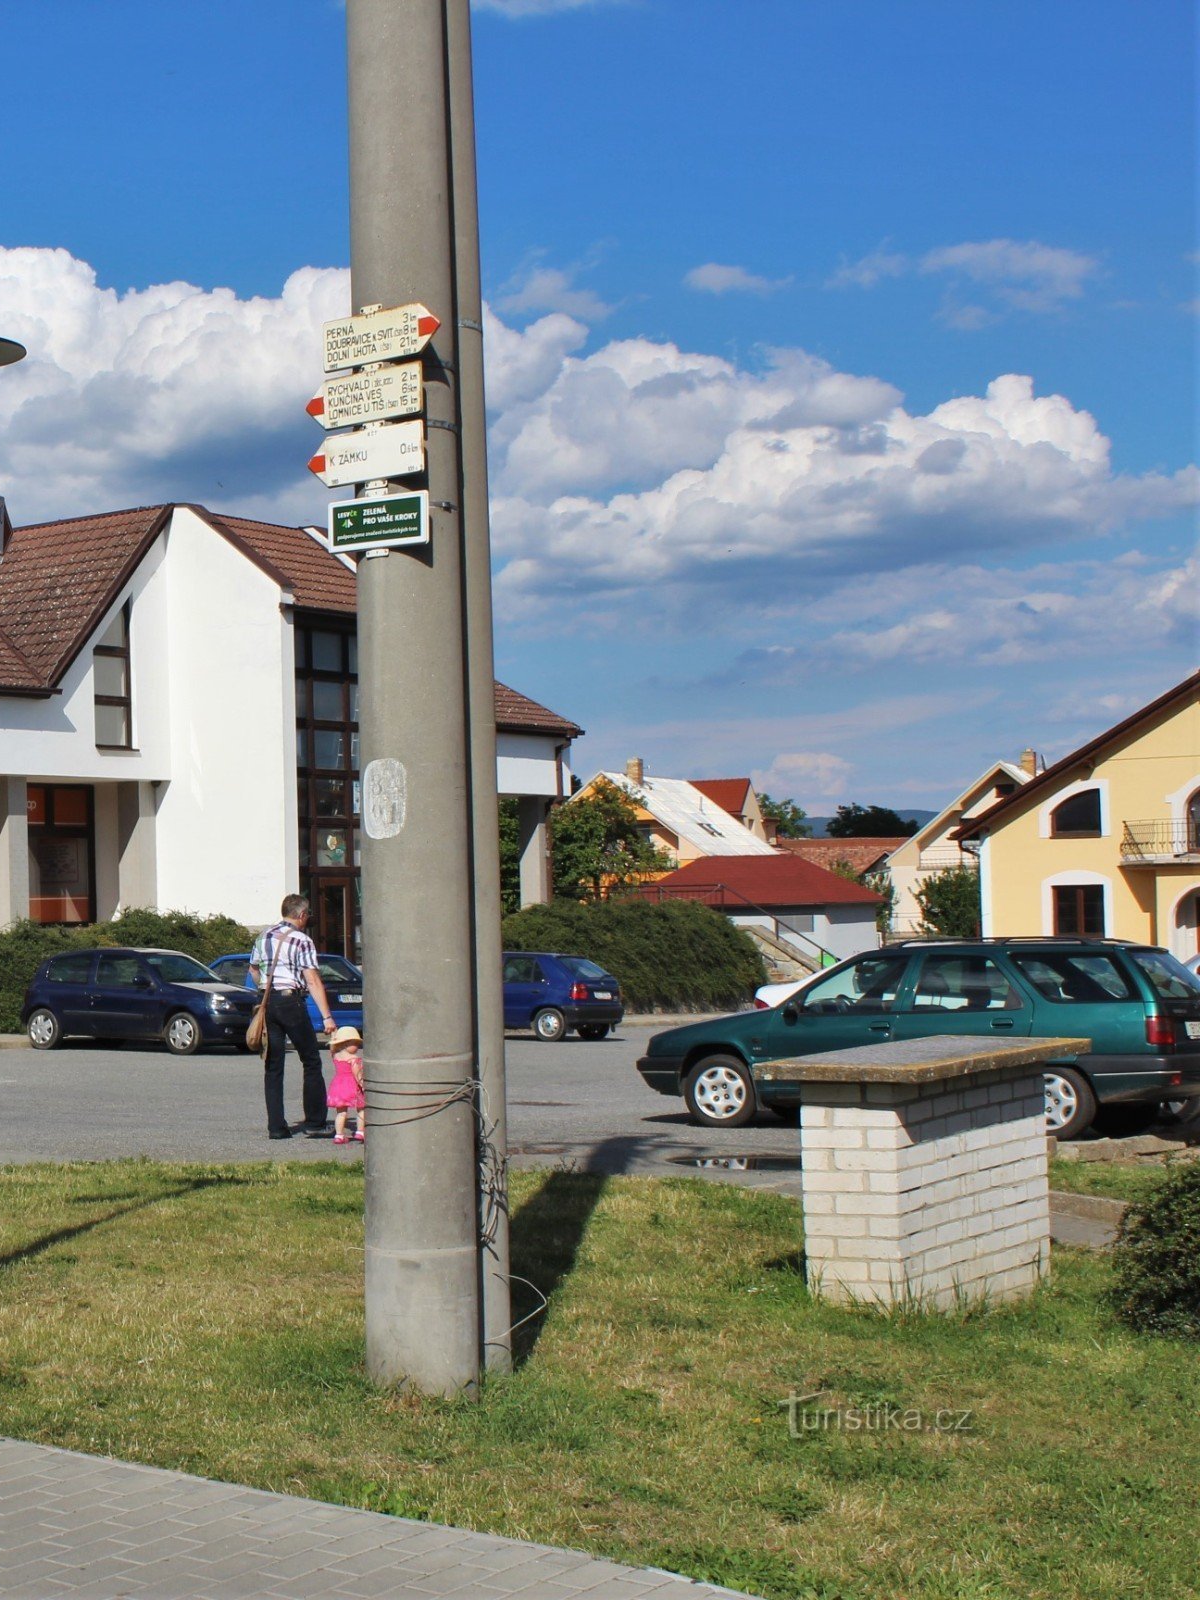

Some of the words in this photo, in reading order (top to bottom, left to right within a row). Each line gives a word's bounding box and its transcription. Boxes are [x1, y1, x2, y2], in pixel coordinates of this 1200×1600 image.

[326, 323, 354, 340] PERNÁ
[402, 313, 409, 324] 3
[409, 313, 417, 322] km
[326, 332, 371, 352] DOUBRAVICE
[403, 324, 409, 335] 8
[410, 324, 417, 334] km
[327, 346, 350, 363] DOLNÍ
[353, 344, 377, 358] LHOTA
[399, 336, 410, 348] 21
[410, 336, 418, 345] km
[327, 380, 370, 397] RYCHVALD
[400, 371, 408, 382] 2
[409, 372, 417, 381] km
[328, 392, 364, 408] KUNČINA
[366, 388, 382, 400] VES
[328, 404, 362, 420] LOMNICE
[363, 402, 370, 413] U
[399, 395, 409, 407] 15
[410, 395, 418, 404] km
[329, 457, 335, 466] K
[338, 450, 368, 465] ZÁMKU
[411, 443, 418, 453] km
[362, 505, 387, 517] ZELENÁ
[362, 517, 376, 525] PRO
[377, 513, 394, 524] VAŠE
[394, 512, 418, 522] KROKY
